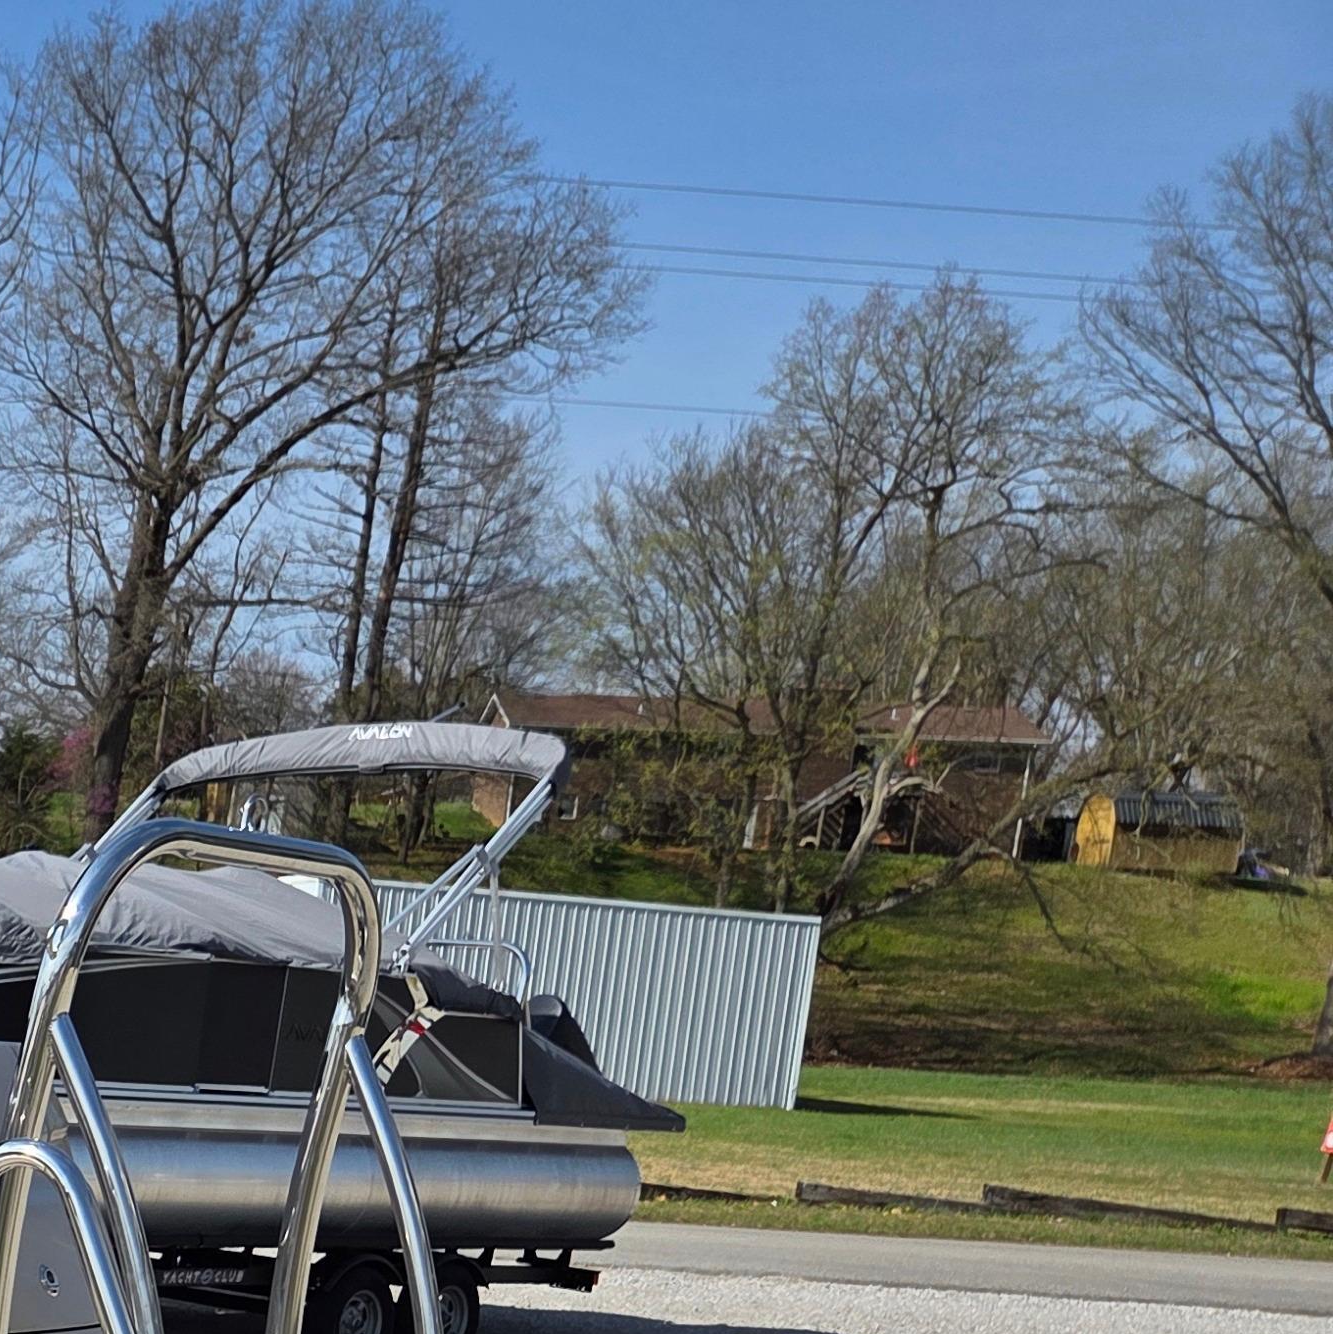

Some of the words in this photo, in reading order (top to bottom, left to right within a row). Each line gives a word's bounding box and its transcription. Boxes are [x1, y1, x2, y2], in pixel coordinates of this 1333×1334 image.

[348, 724, 413, 740] AVALON
[162, 1270, 201, 1284] YACHT
[214, 1269, 244, 1283] CLUB
